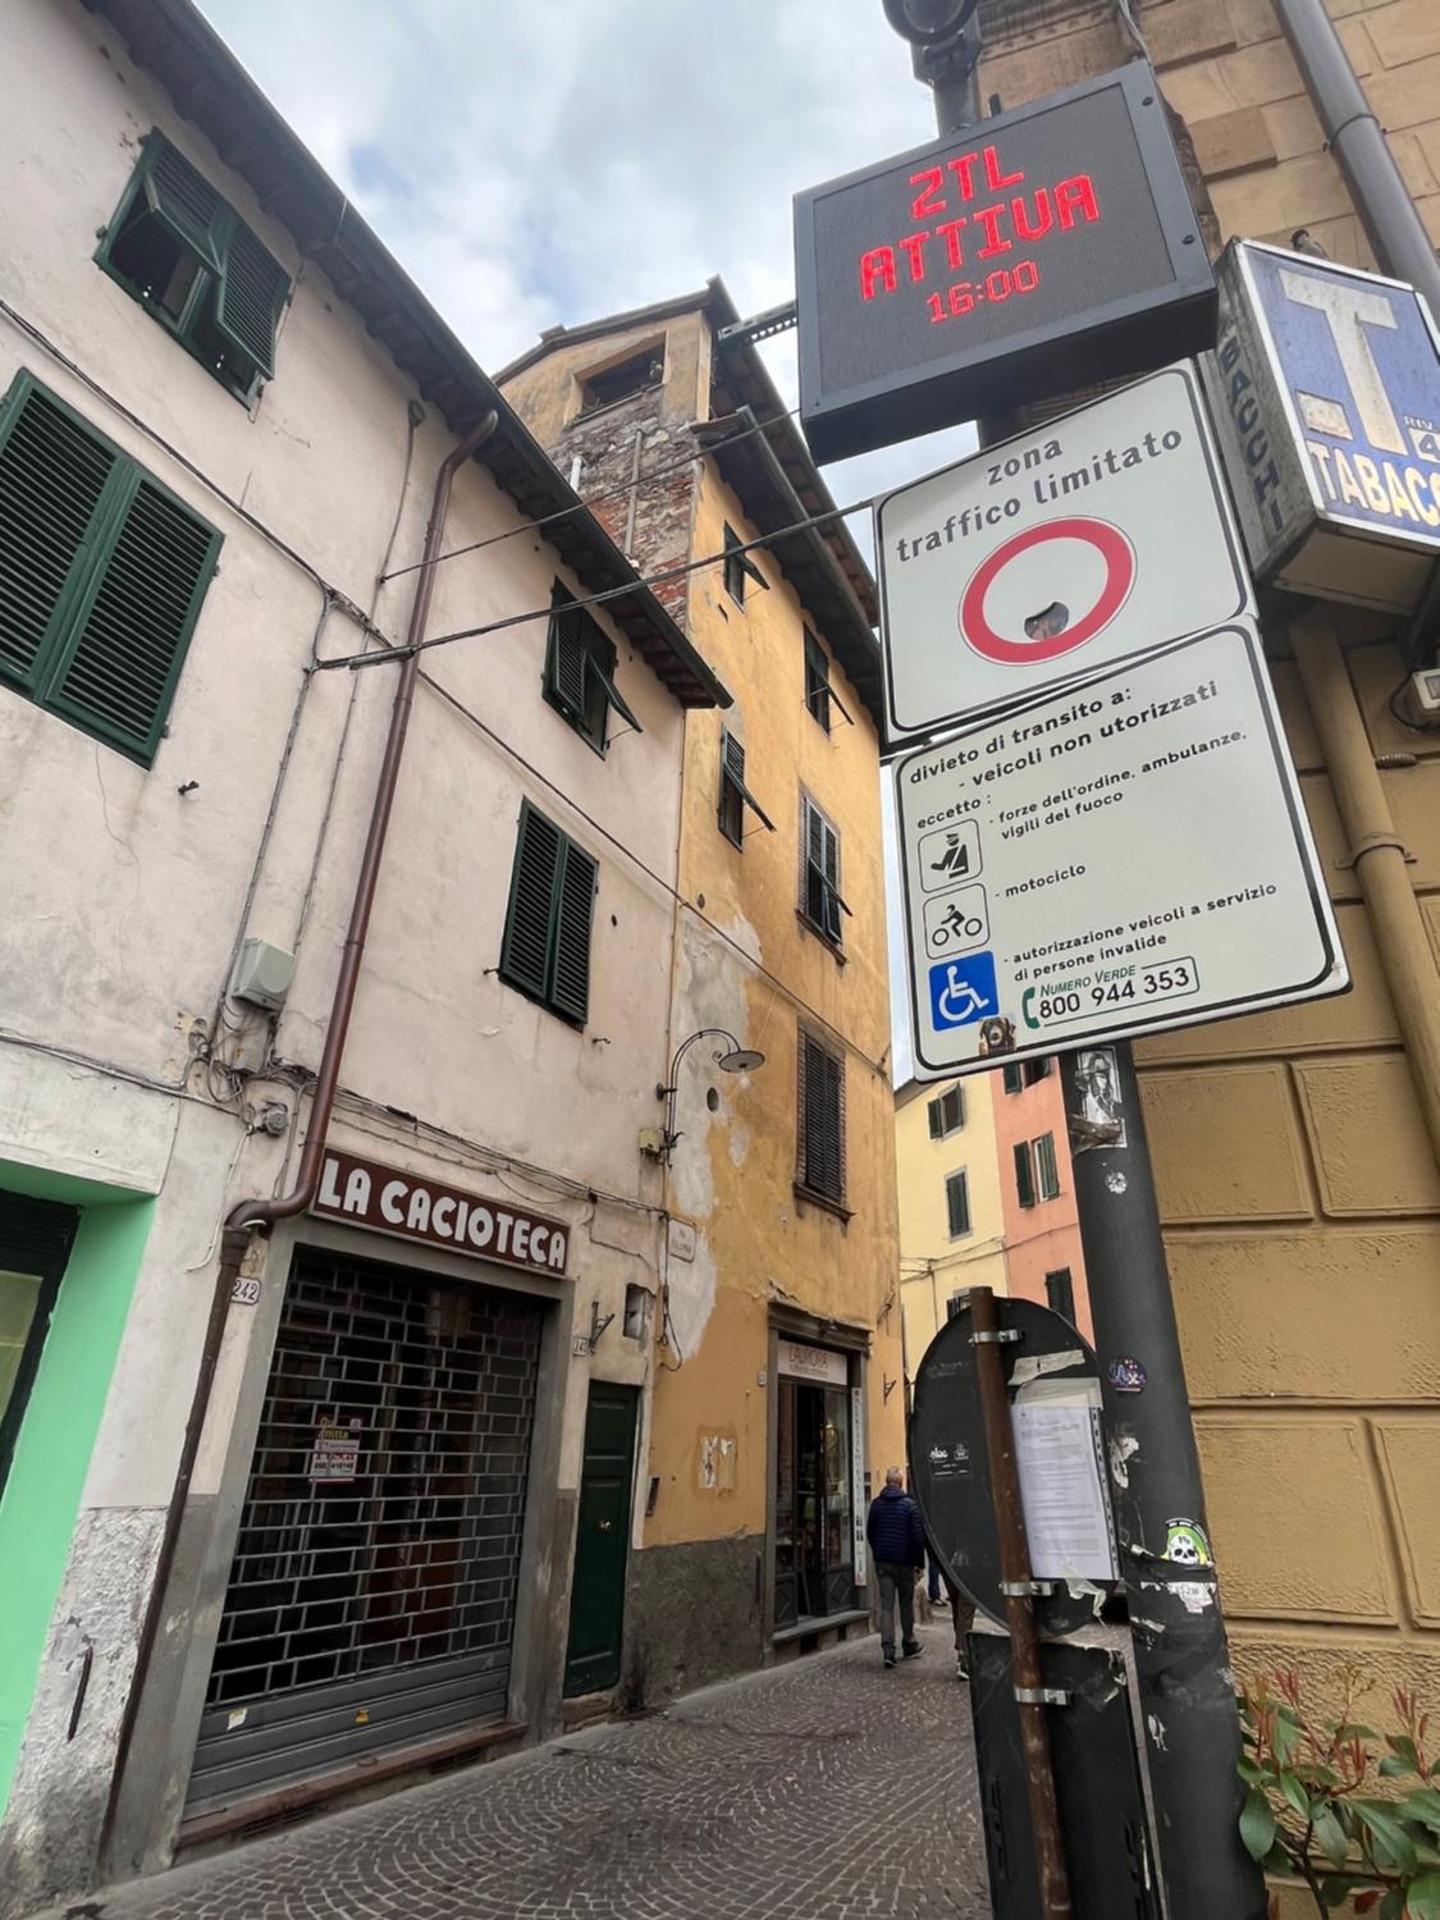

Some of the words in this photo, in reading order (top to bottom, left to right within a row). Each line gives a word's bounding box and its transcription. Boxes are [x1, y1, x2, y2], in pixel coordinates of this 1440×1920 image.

[909, 145, 1024, 219] ZTL
[859, 173, 1099, 300] ATTIVA
[926, 260, 1039, 323] 16:00
[987, 439, 1063, 486] zona
[897, 498, 1021, 562] traffico
[1034, 430, 1182, 504] limitato
[909, 748, 979, 785] divieto
[986, 735, 1006, 754] di
[1011, 699, 1103, 744] transito
[1110, 688, 1131, 706] a:
[972, 748, 1042, 786] veicoli
[1050, 732, 1092, 758] non
[1100, 681, 1218, 738] utorizzati
[999, 801, 1038, 824] forze
[1001, 818, 1040, 840] vigili
[1045, 808, 1071, 826] del
[1075, 792, 1124, 816] fuoco
[1005, 863, 1087, 898] motociclo
[1013, 923, 1125, 963] autorizzazione
[1128, 906, 1185, 932] veicoli
[1190, 903, 1201, 915] a
[1206, 882, 1278, 911] servizio
[1014, 968, 1029, 982] di
[1033, 951, 1096, 979] persone
[1100, 932, 1168, 960] invalide
[1095, 964, 1137, 984] VERDE
[1039, 992, 1081, 1019] 800
[1091, 980, 1136, 1007] 944
[1143, 966, 1190, 994] 353
[318, 1156, 372, 1216] LA
[379, 1179, 567, 1270] CACIOTECA
[231, 1279, 257, 1301] 242
